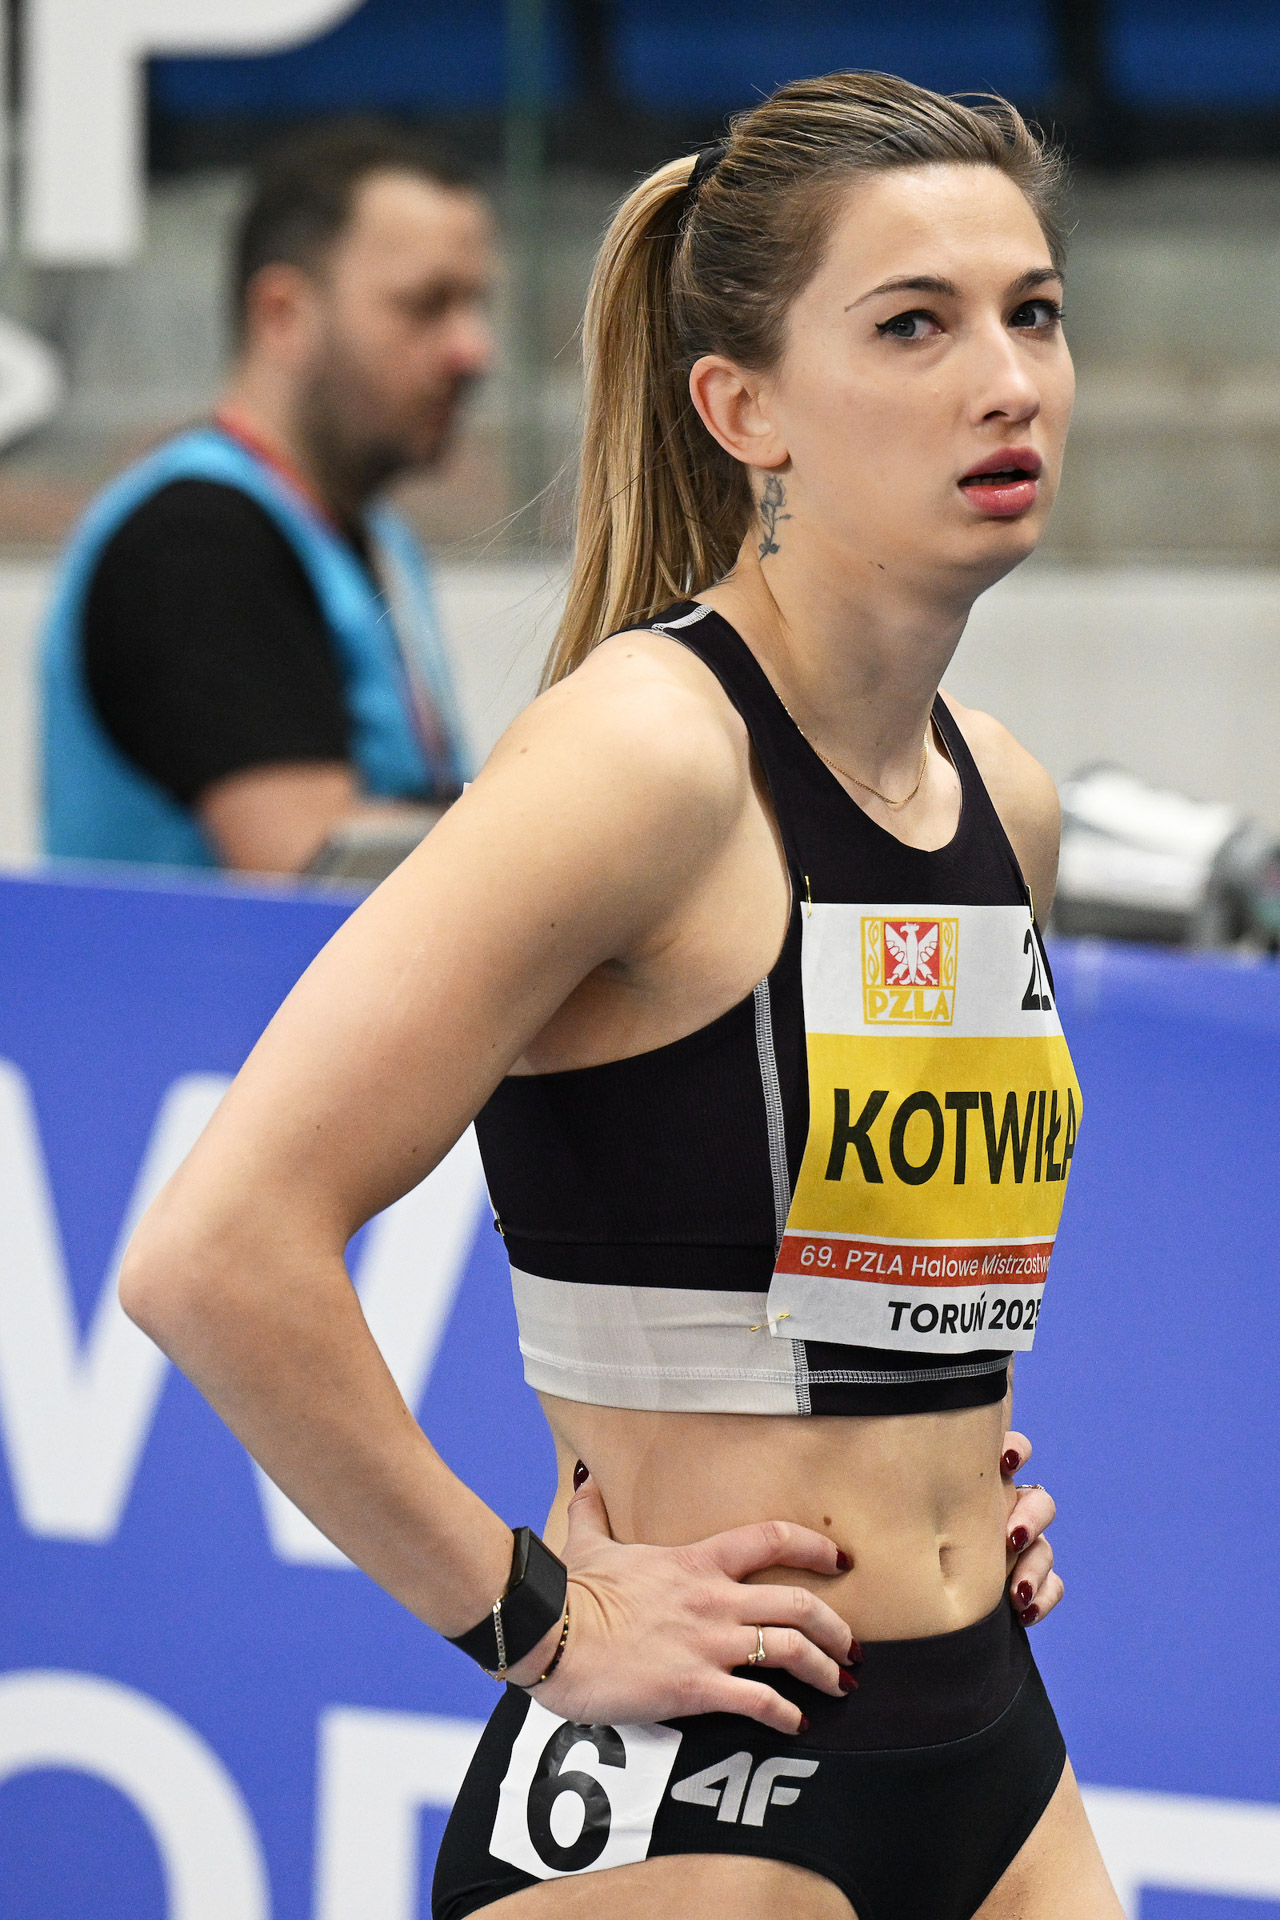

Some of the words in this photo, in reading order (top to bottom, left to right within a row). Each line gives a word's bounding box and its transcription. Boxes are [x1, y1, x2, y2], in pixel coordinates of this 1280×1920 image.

[868, 990, 949, 1020] PZLA
[825, 1088, 1077, 1185] KOTWIŁA
[801, 1244, 836, 1269] 69.
[845, 1250, 903, 1276] PZLA
[911, 1254, 979, 1277] Halowe
[888, 1290, 987, 1334] TORUŃ
[526, 1722, 627, 1872] 6
[671, 1751, 820, 1827] 4F
